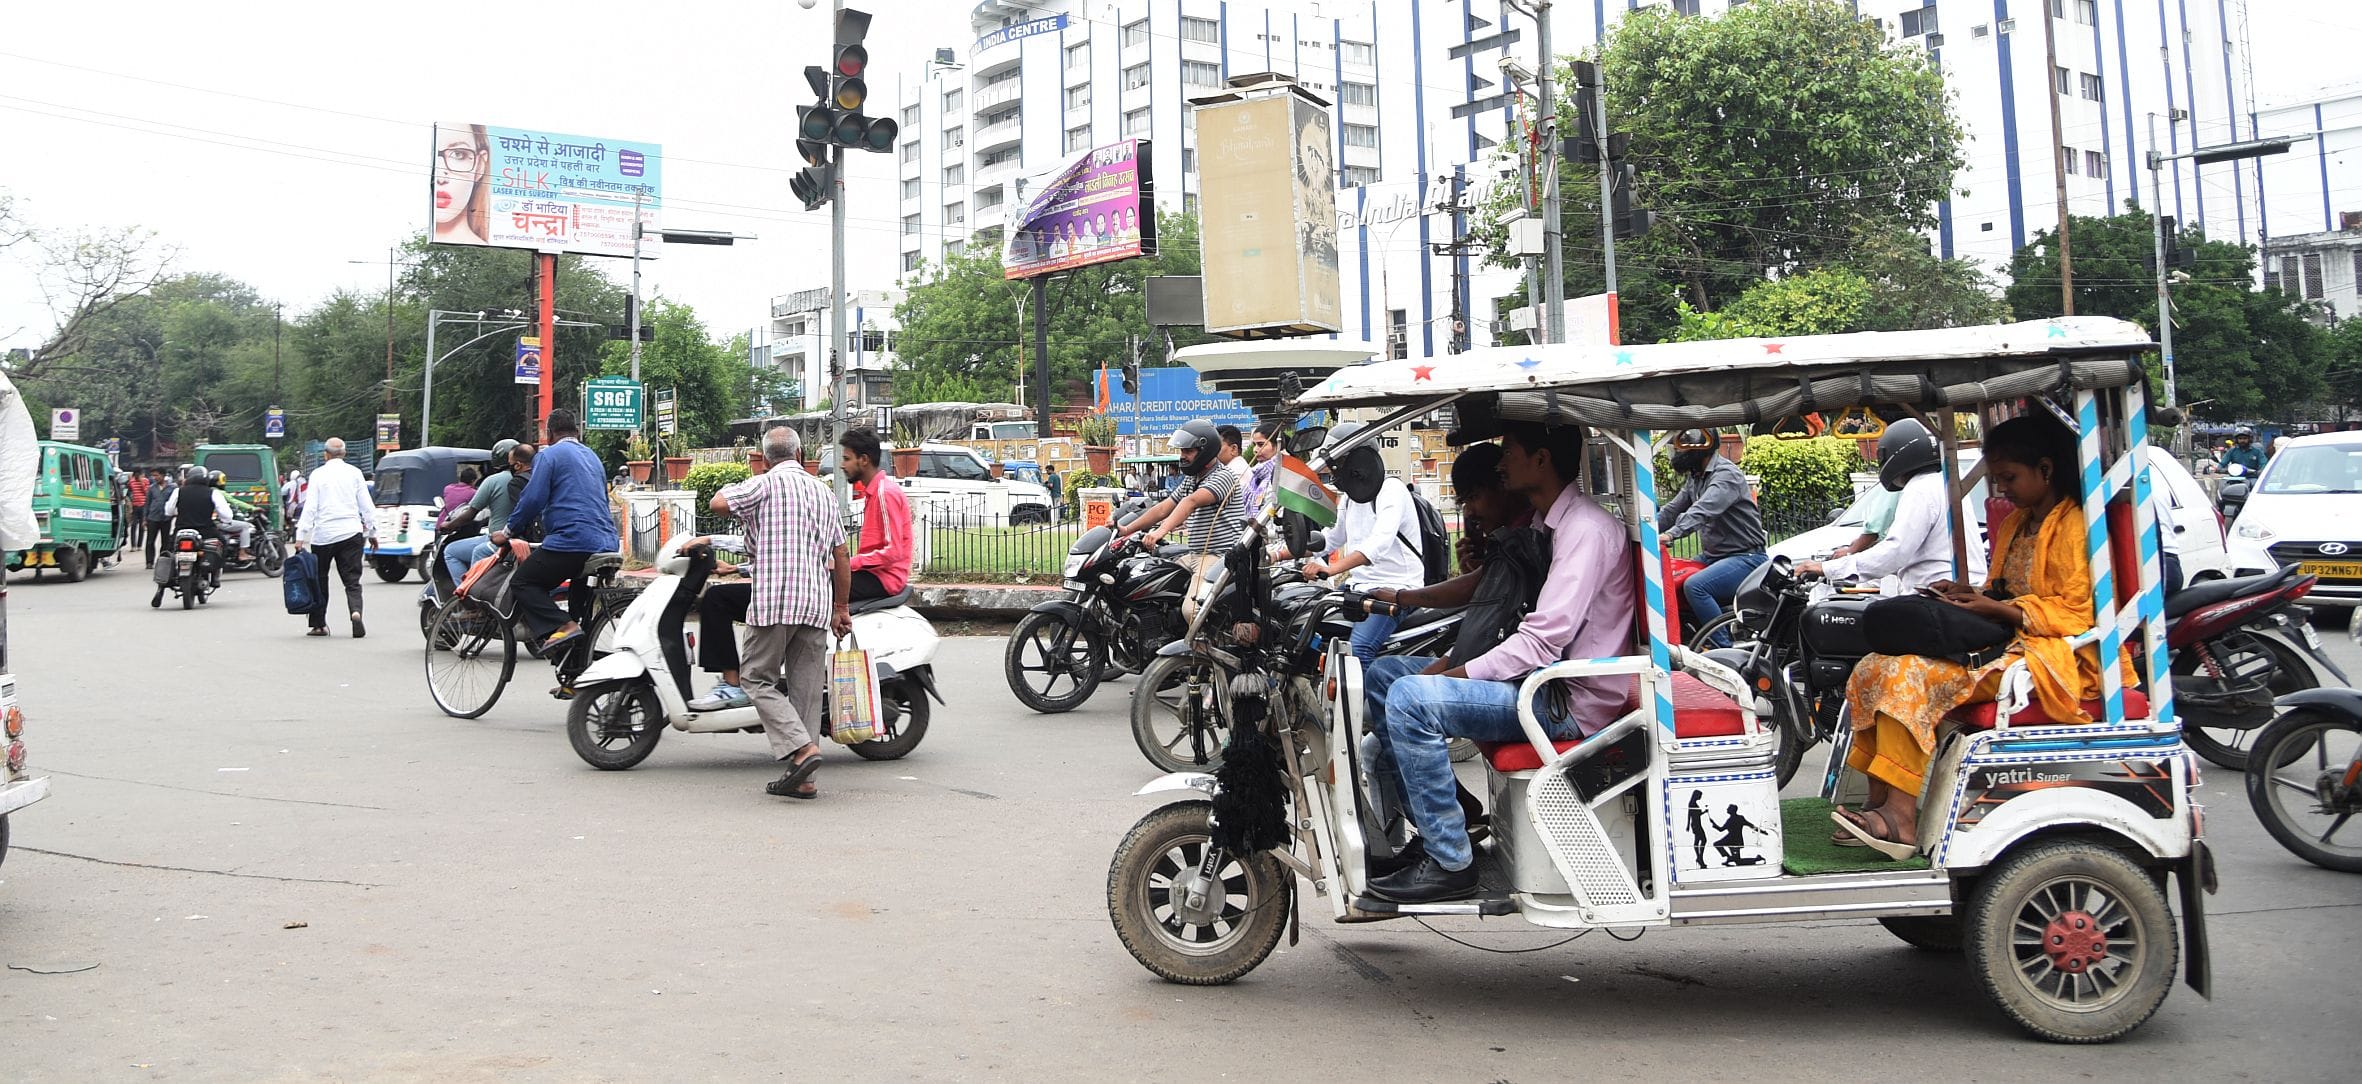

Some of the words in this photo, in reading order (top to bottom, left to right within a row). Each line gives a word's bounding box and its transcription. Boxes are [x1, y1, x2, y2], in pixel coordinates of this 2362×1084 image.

[982, 31, 1007, 49] INDIA
[1008, 18, 1058, 40] CENTRE
[499, 134, 533, 153] चश्मे
[536, 136, 549, 155] से
[554, 143, 606, 162] आजादी
[504, 155, 524, 166] उत्तर
[527, 155, 548, 168] प्रदेश
[560, 160, 583, 172] पहली
[576, 178, 588, 189] की
[493, 187, 513, 195] LASER
[515, 189, 527, 197] EYE
[529, 190, 559, 199] SURGERY
[536, 201, 568, 215] भाटिया
[1360, 193, 1419, 225] India
[512, 212, 568, 236] चन्द्रा
[593, 390, 634, 407] SRGI
[1107, 402, 1136, 413] AHARA
[1140, 400, 1172, 412] CREDIT
[1174, 399, 1237, 412] COOPERATIVE
[1088, 504, 1105, 515] PG
[1985, 767, 2032, 788] yatri
[2036, 772, 2072, 783] Super
[1204, 851, 1217, 874] yatri
